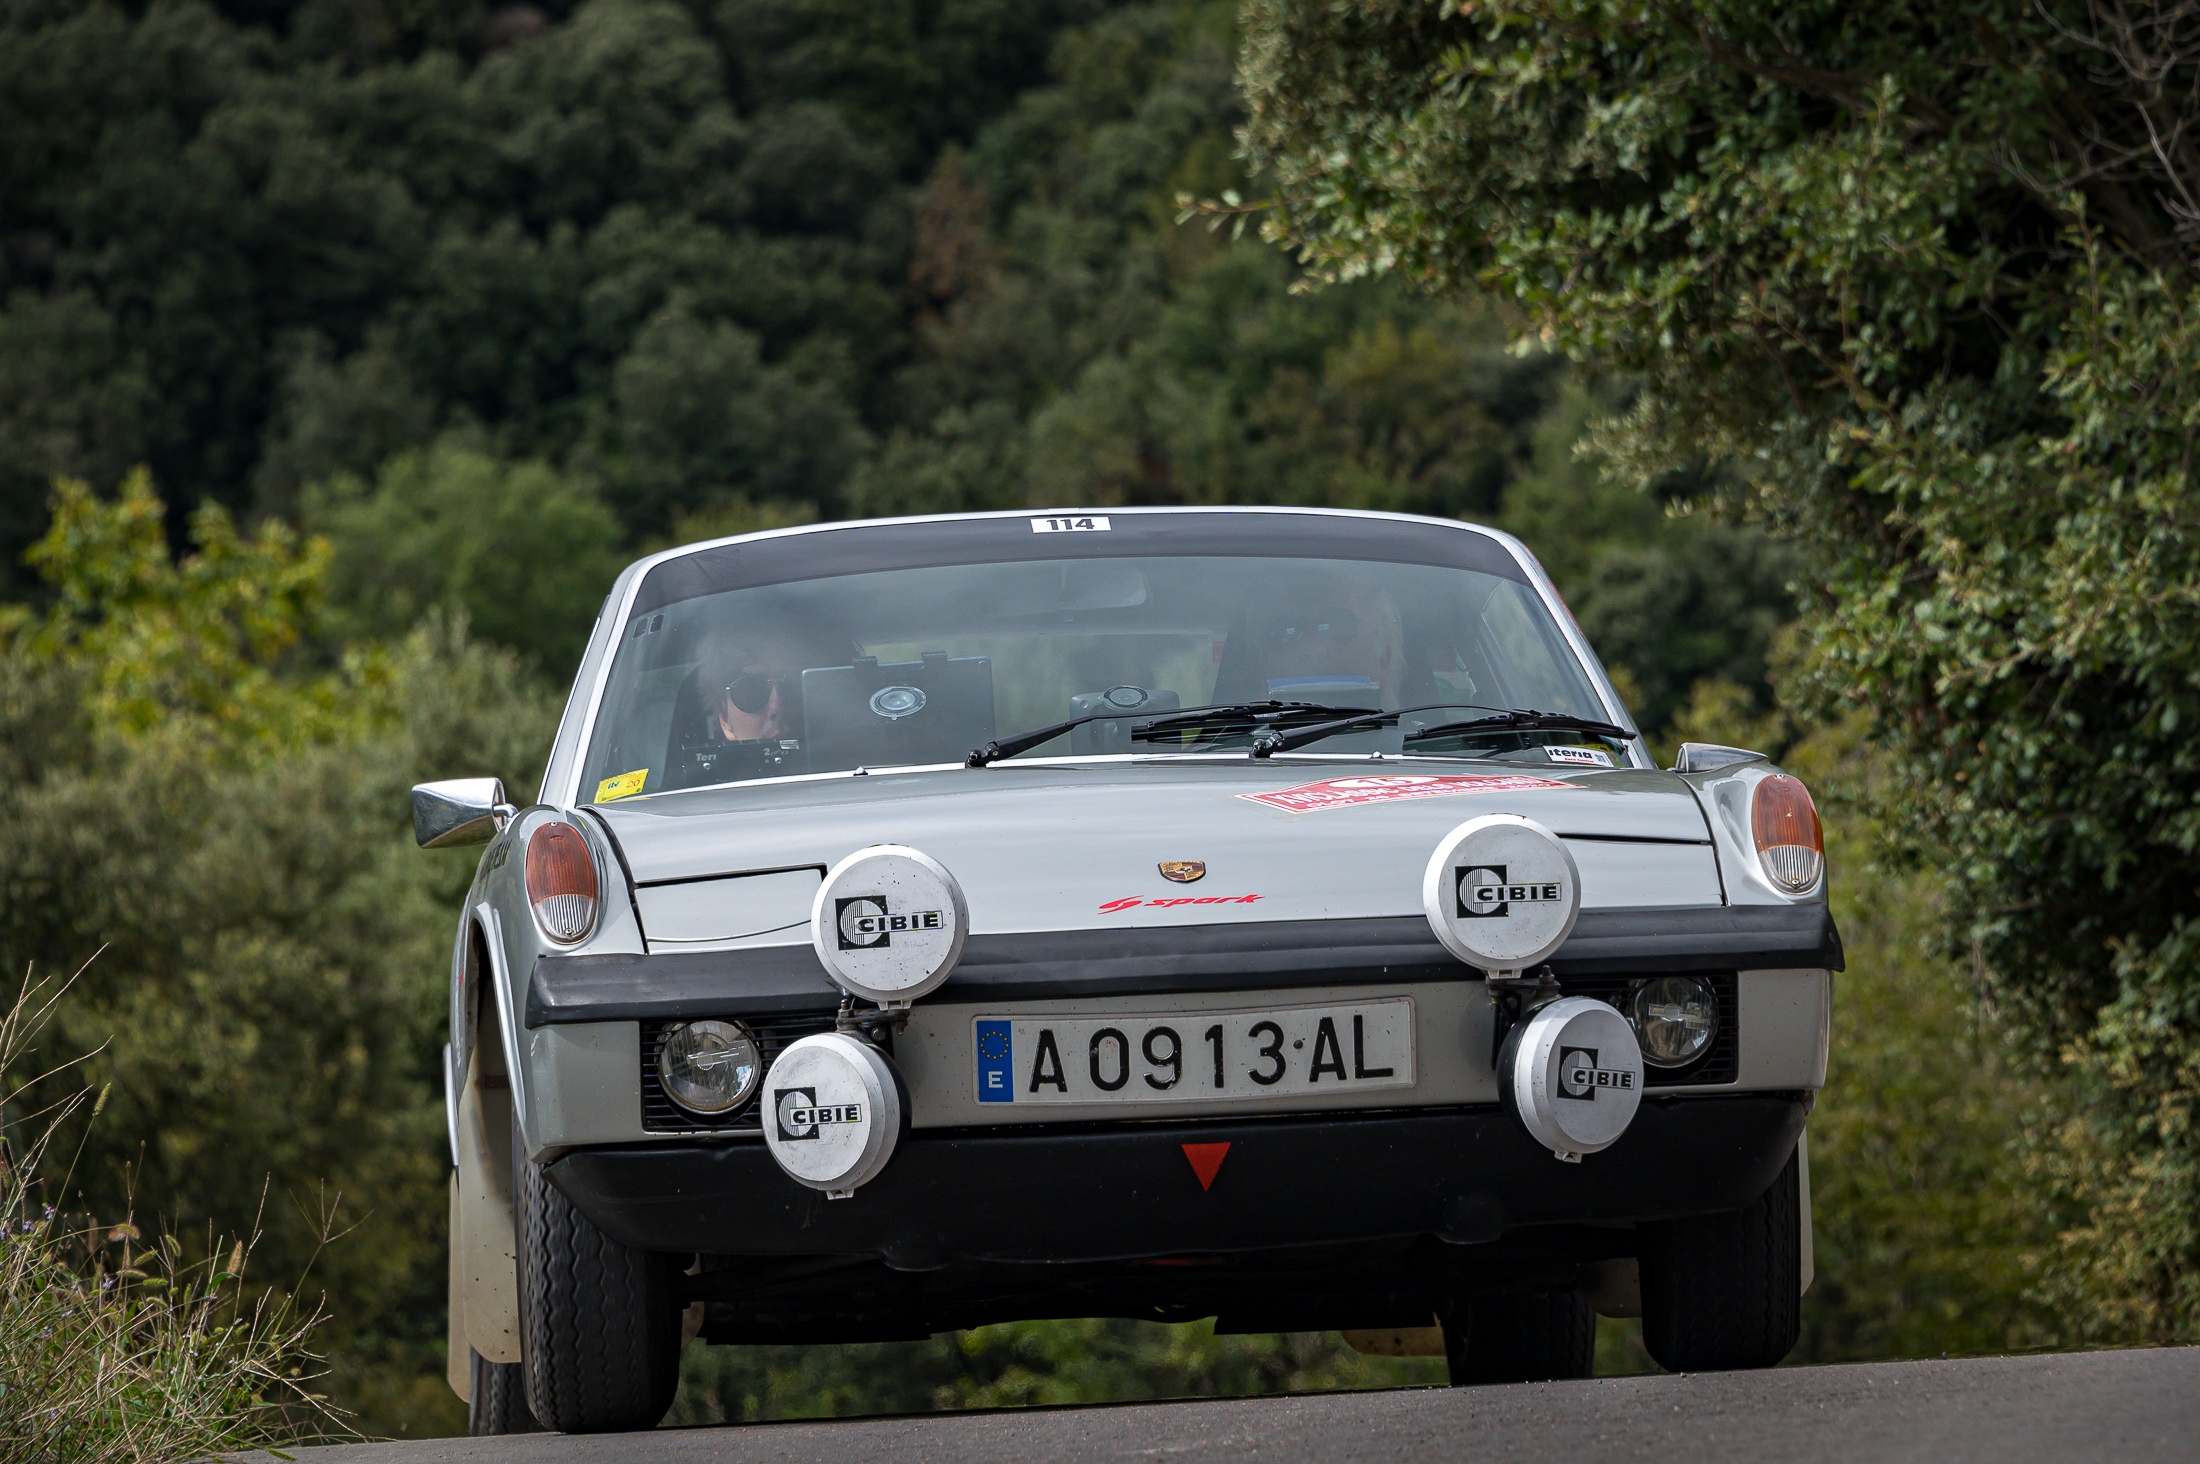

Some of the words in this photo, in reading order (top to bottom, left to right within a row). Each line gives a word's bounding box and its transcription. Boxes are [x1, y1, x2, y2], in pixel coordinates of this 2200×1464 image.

[1046, 518, 1095, 531] 114
[626, 779, 641, 789] 20
[988, 1071, 1003, 1088] E
